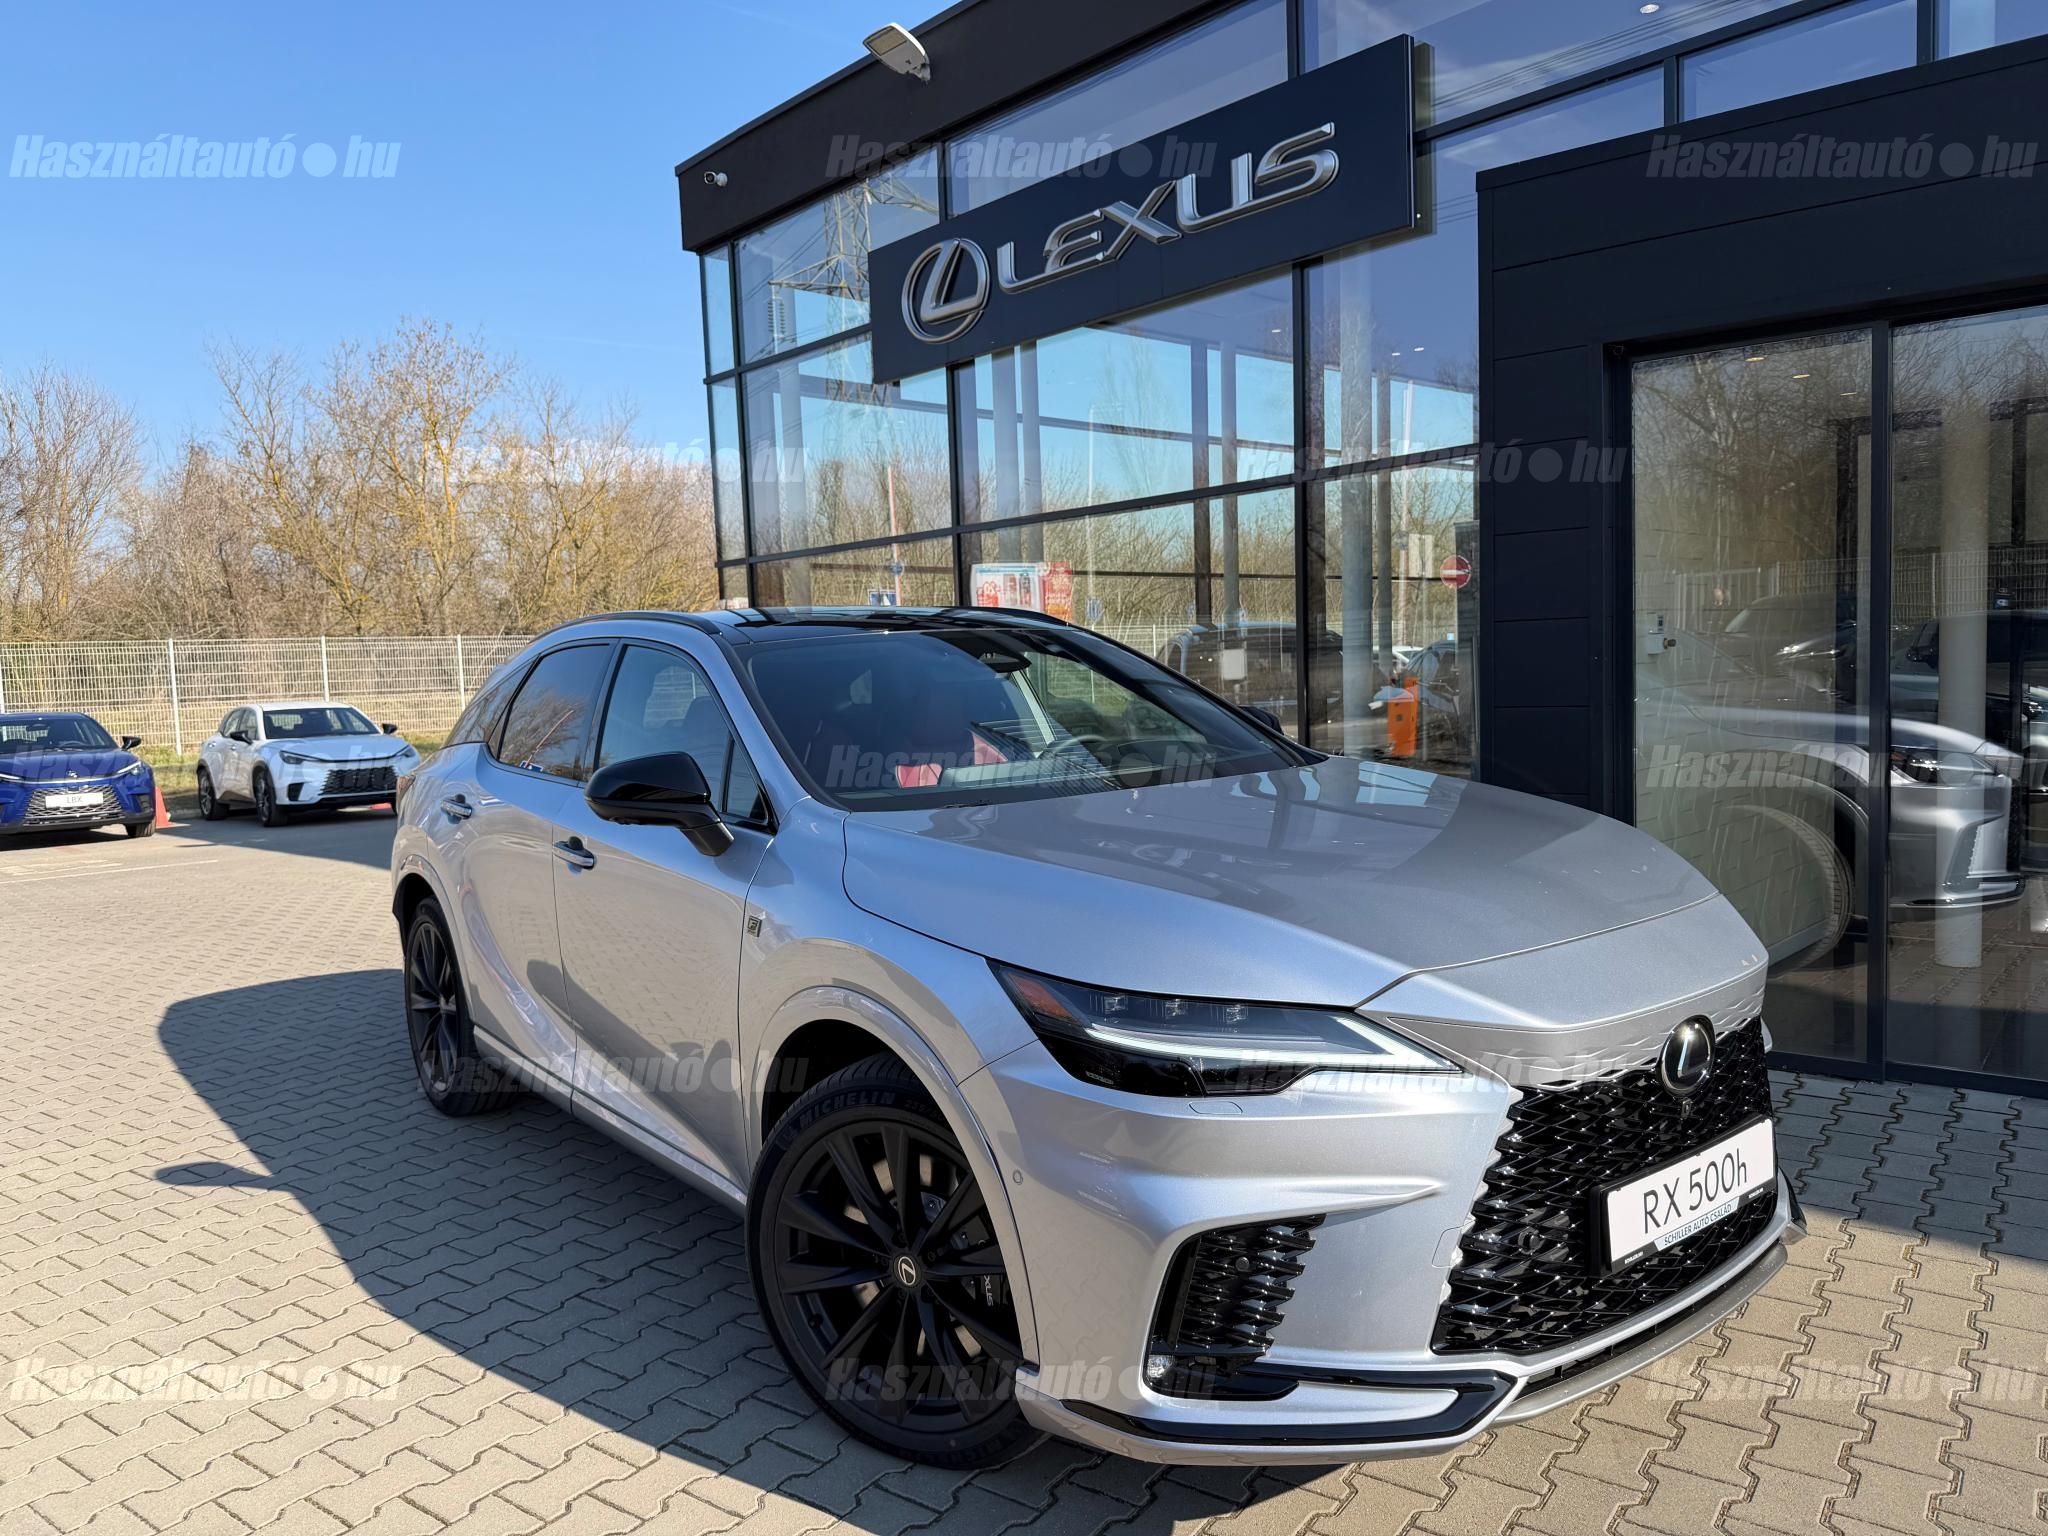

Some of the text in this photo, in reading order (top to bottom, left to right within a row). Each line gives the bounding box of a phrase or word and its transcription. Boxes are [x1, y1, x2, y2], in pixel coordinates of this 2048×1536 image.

[997, 121, 1339, 294] LEXUS
[798, 1091, 896, 1128] MICHELIN
[1643, 1148, 1748, 1234] RX 500h
[1663, 1225, 1692, 1246] SCHILLER
[1710, 1203, 1732, 1225] CSALÁD
